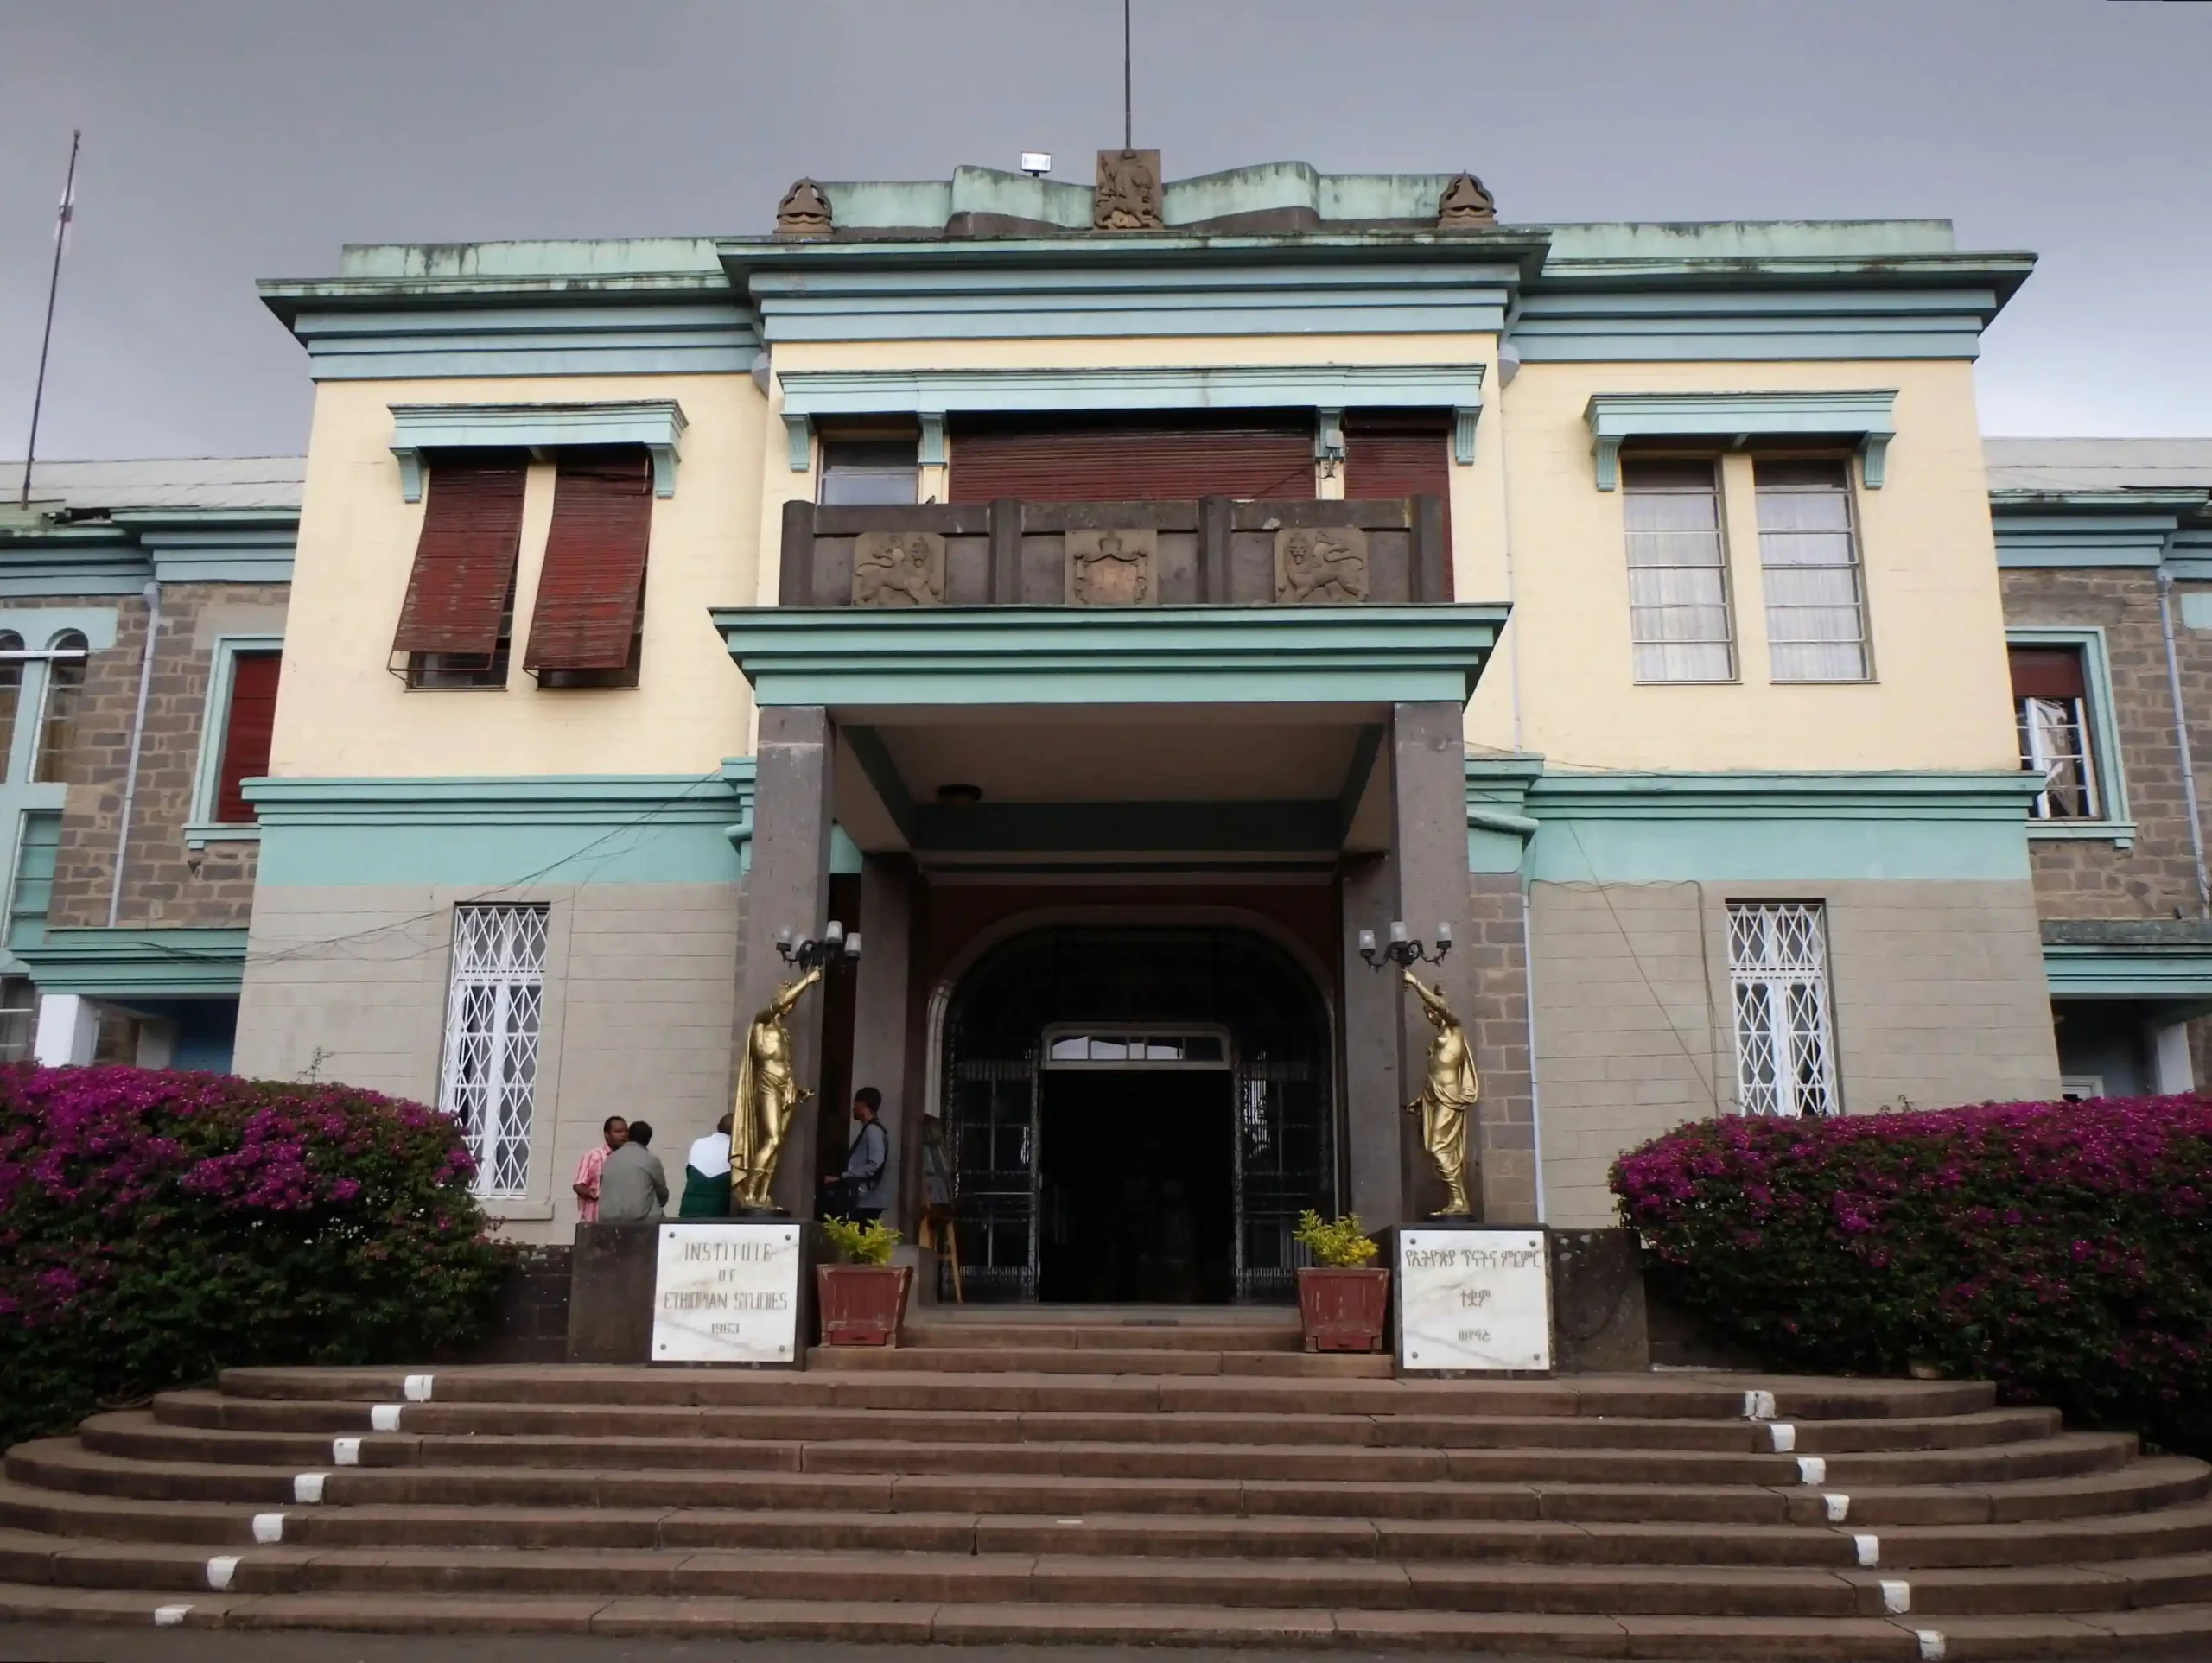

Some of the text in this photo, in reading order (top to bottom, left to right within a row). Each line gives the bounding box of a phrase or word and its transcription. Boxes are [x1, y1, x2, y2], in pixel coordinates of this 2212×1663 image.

[684, 1242, 772, 1261] INSTITUTE
[718, 1268, 737, 1282] OF
[664, 1292, 788, 1311] ETHIOPIAN STUDIES
[711, 1323, 740, 1335] 1963
